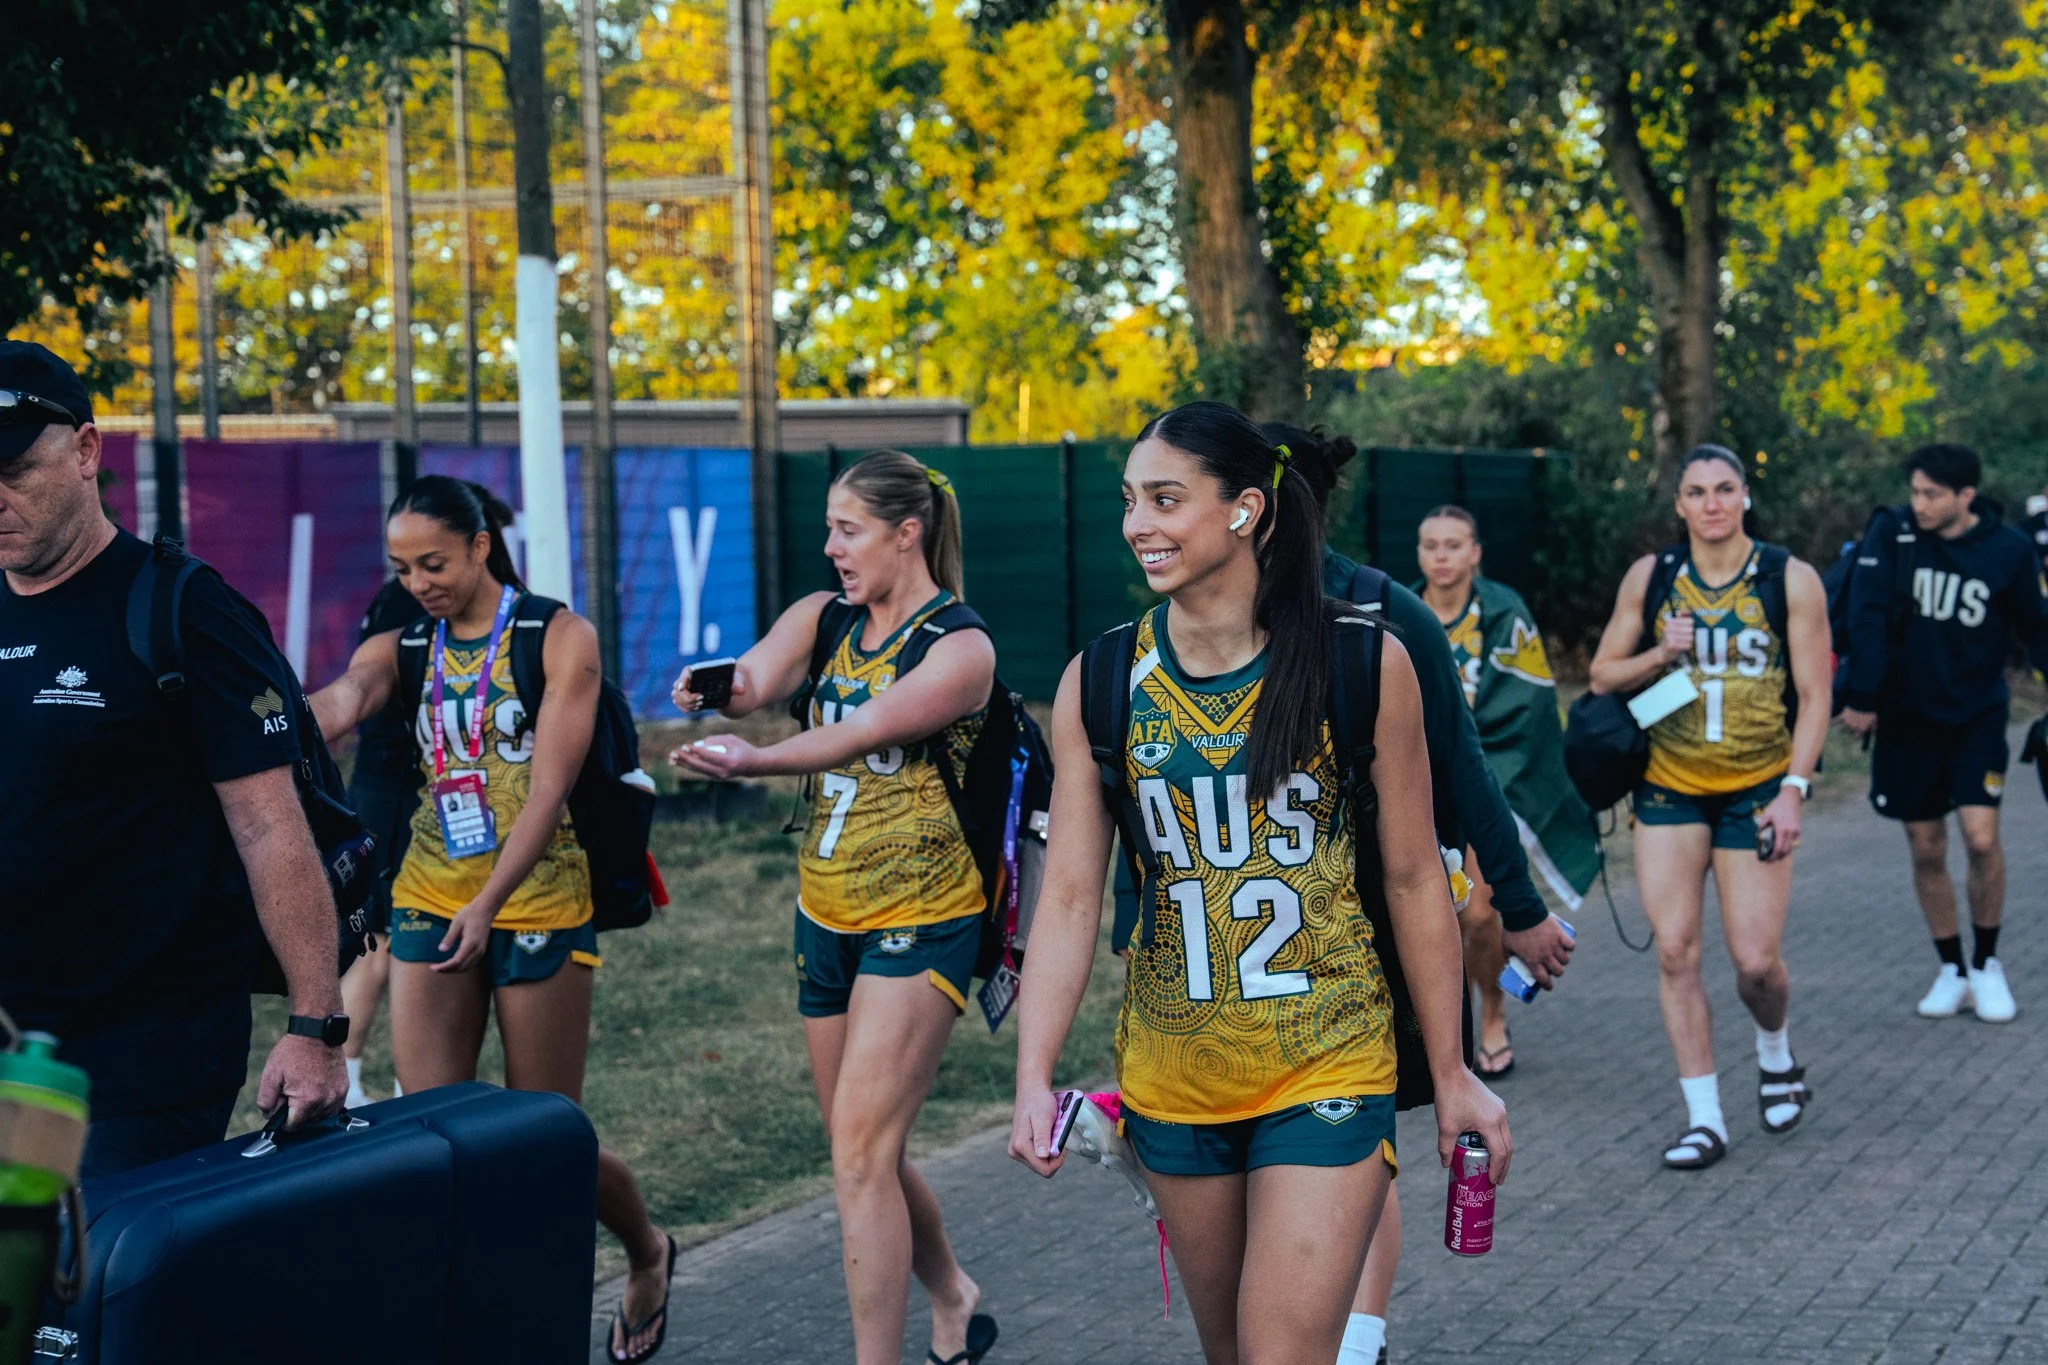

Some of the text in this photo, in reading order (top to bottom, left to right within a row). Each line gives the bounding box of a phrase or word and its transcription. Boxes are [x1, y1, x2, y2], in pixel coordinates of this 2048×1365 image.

[1913, 568, 1990, 628] AUS
[0, 645, 37, 660] ALOUR
[1684, 627, 1770, 677] US
[264, 715, 288, 735] AIS
[415, 697, 536, 767] AUS
[1129, 719, 1174, 745] AFA
[1700, 679, 1725, 743] 1
[1192, 733, 1246, 749] VALOUR
[818, 772, 858, 859] 7
[1137, 772, 1319, 868] AUS
[1168, 878, 1310, 999] 12
[1456, 1200, 1483, 1208] EDITION
[1457, 1189, 1495, 1202] PEAC
[1451, 1206, 1463, 1249] Red Bull
